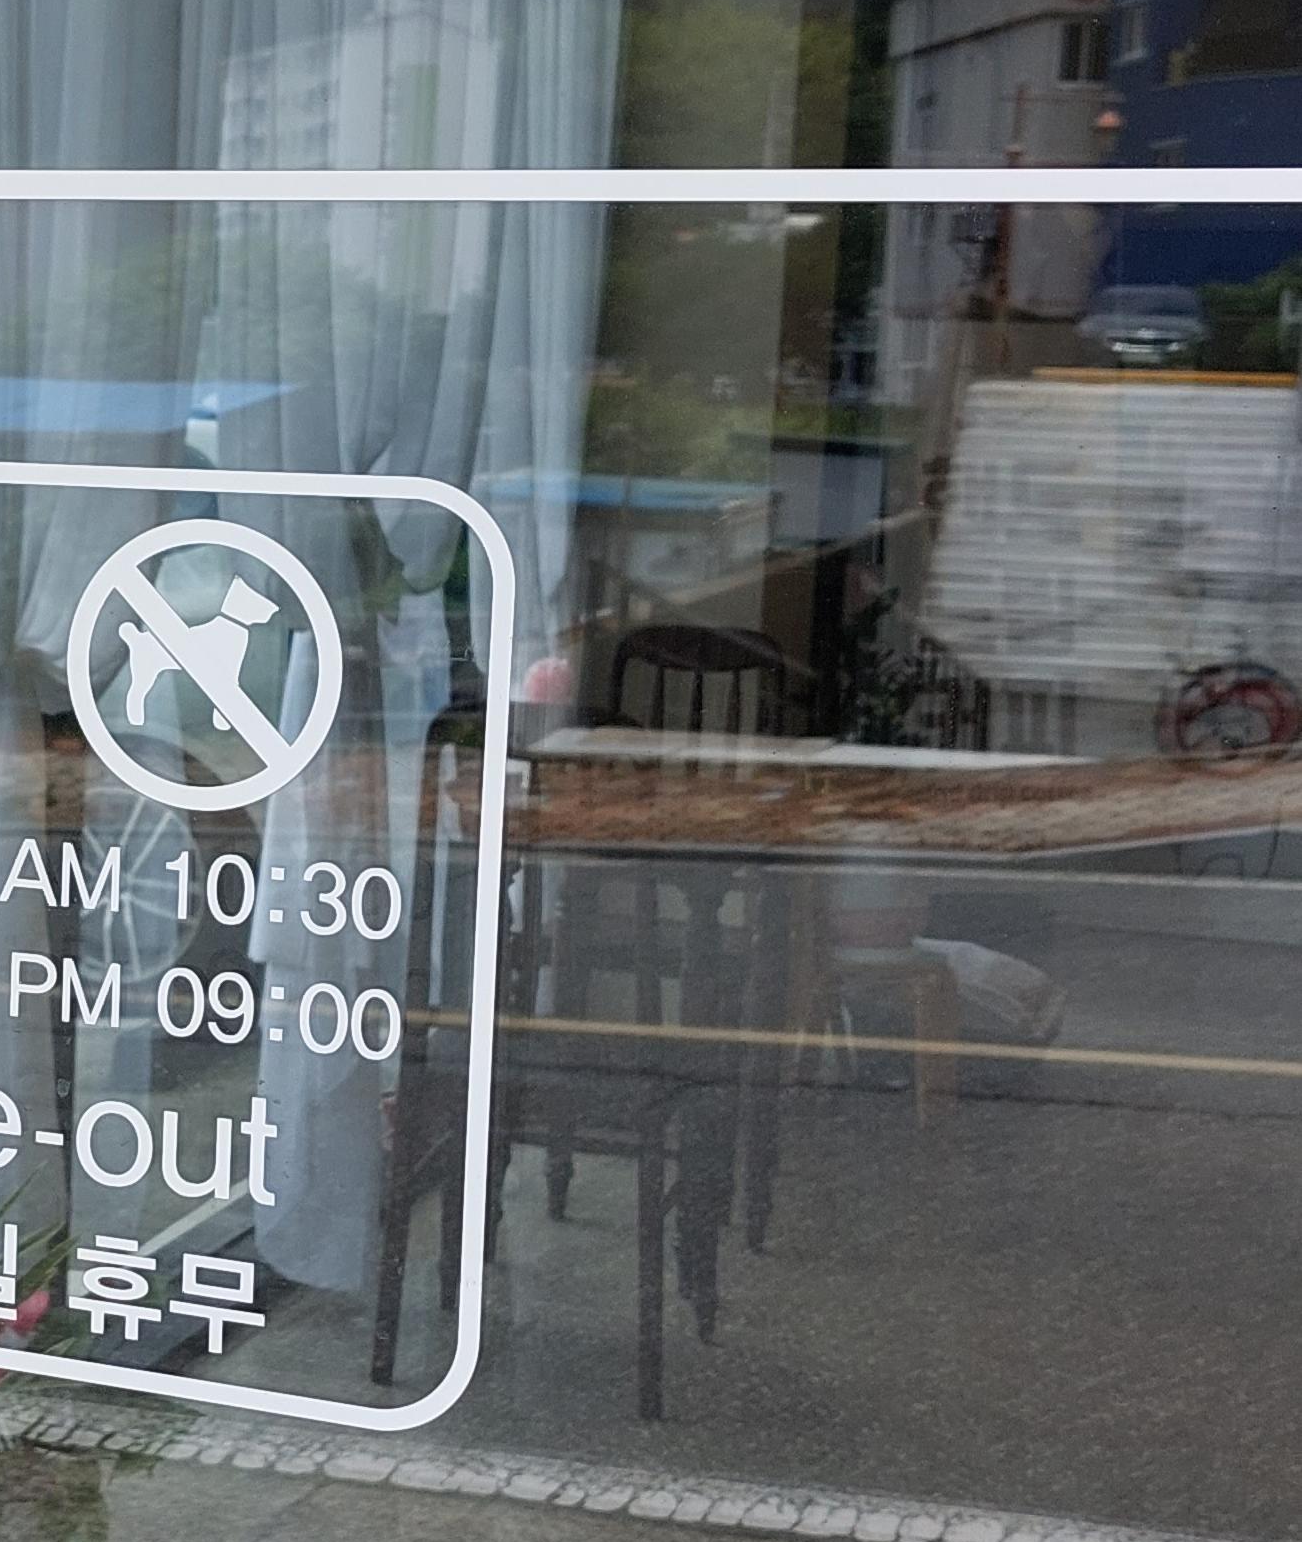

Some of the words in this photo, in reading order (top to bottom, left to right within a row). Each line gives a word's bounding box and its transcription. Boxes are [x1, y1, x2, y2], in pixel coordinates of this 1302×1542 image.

[0, 839, 122, 913] AM
[165, 849, 403, 941] 10:30
[9, 952, 122, 1029] PM
[156, 966, 403, 1061] 09:00
[68, 1234, 267, 1356] 휴무
